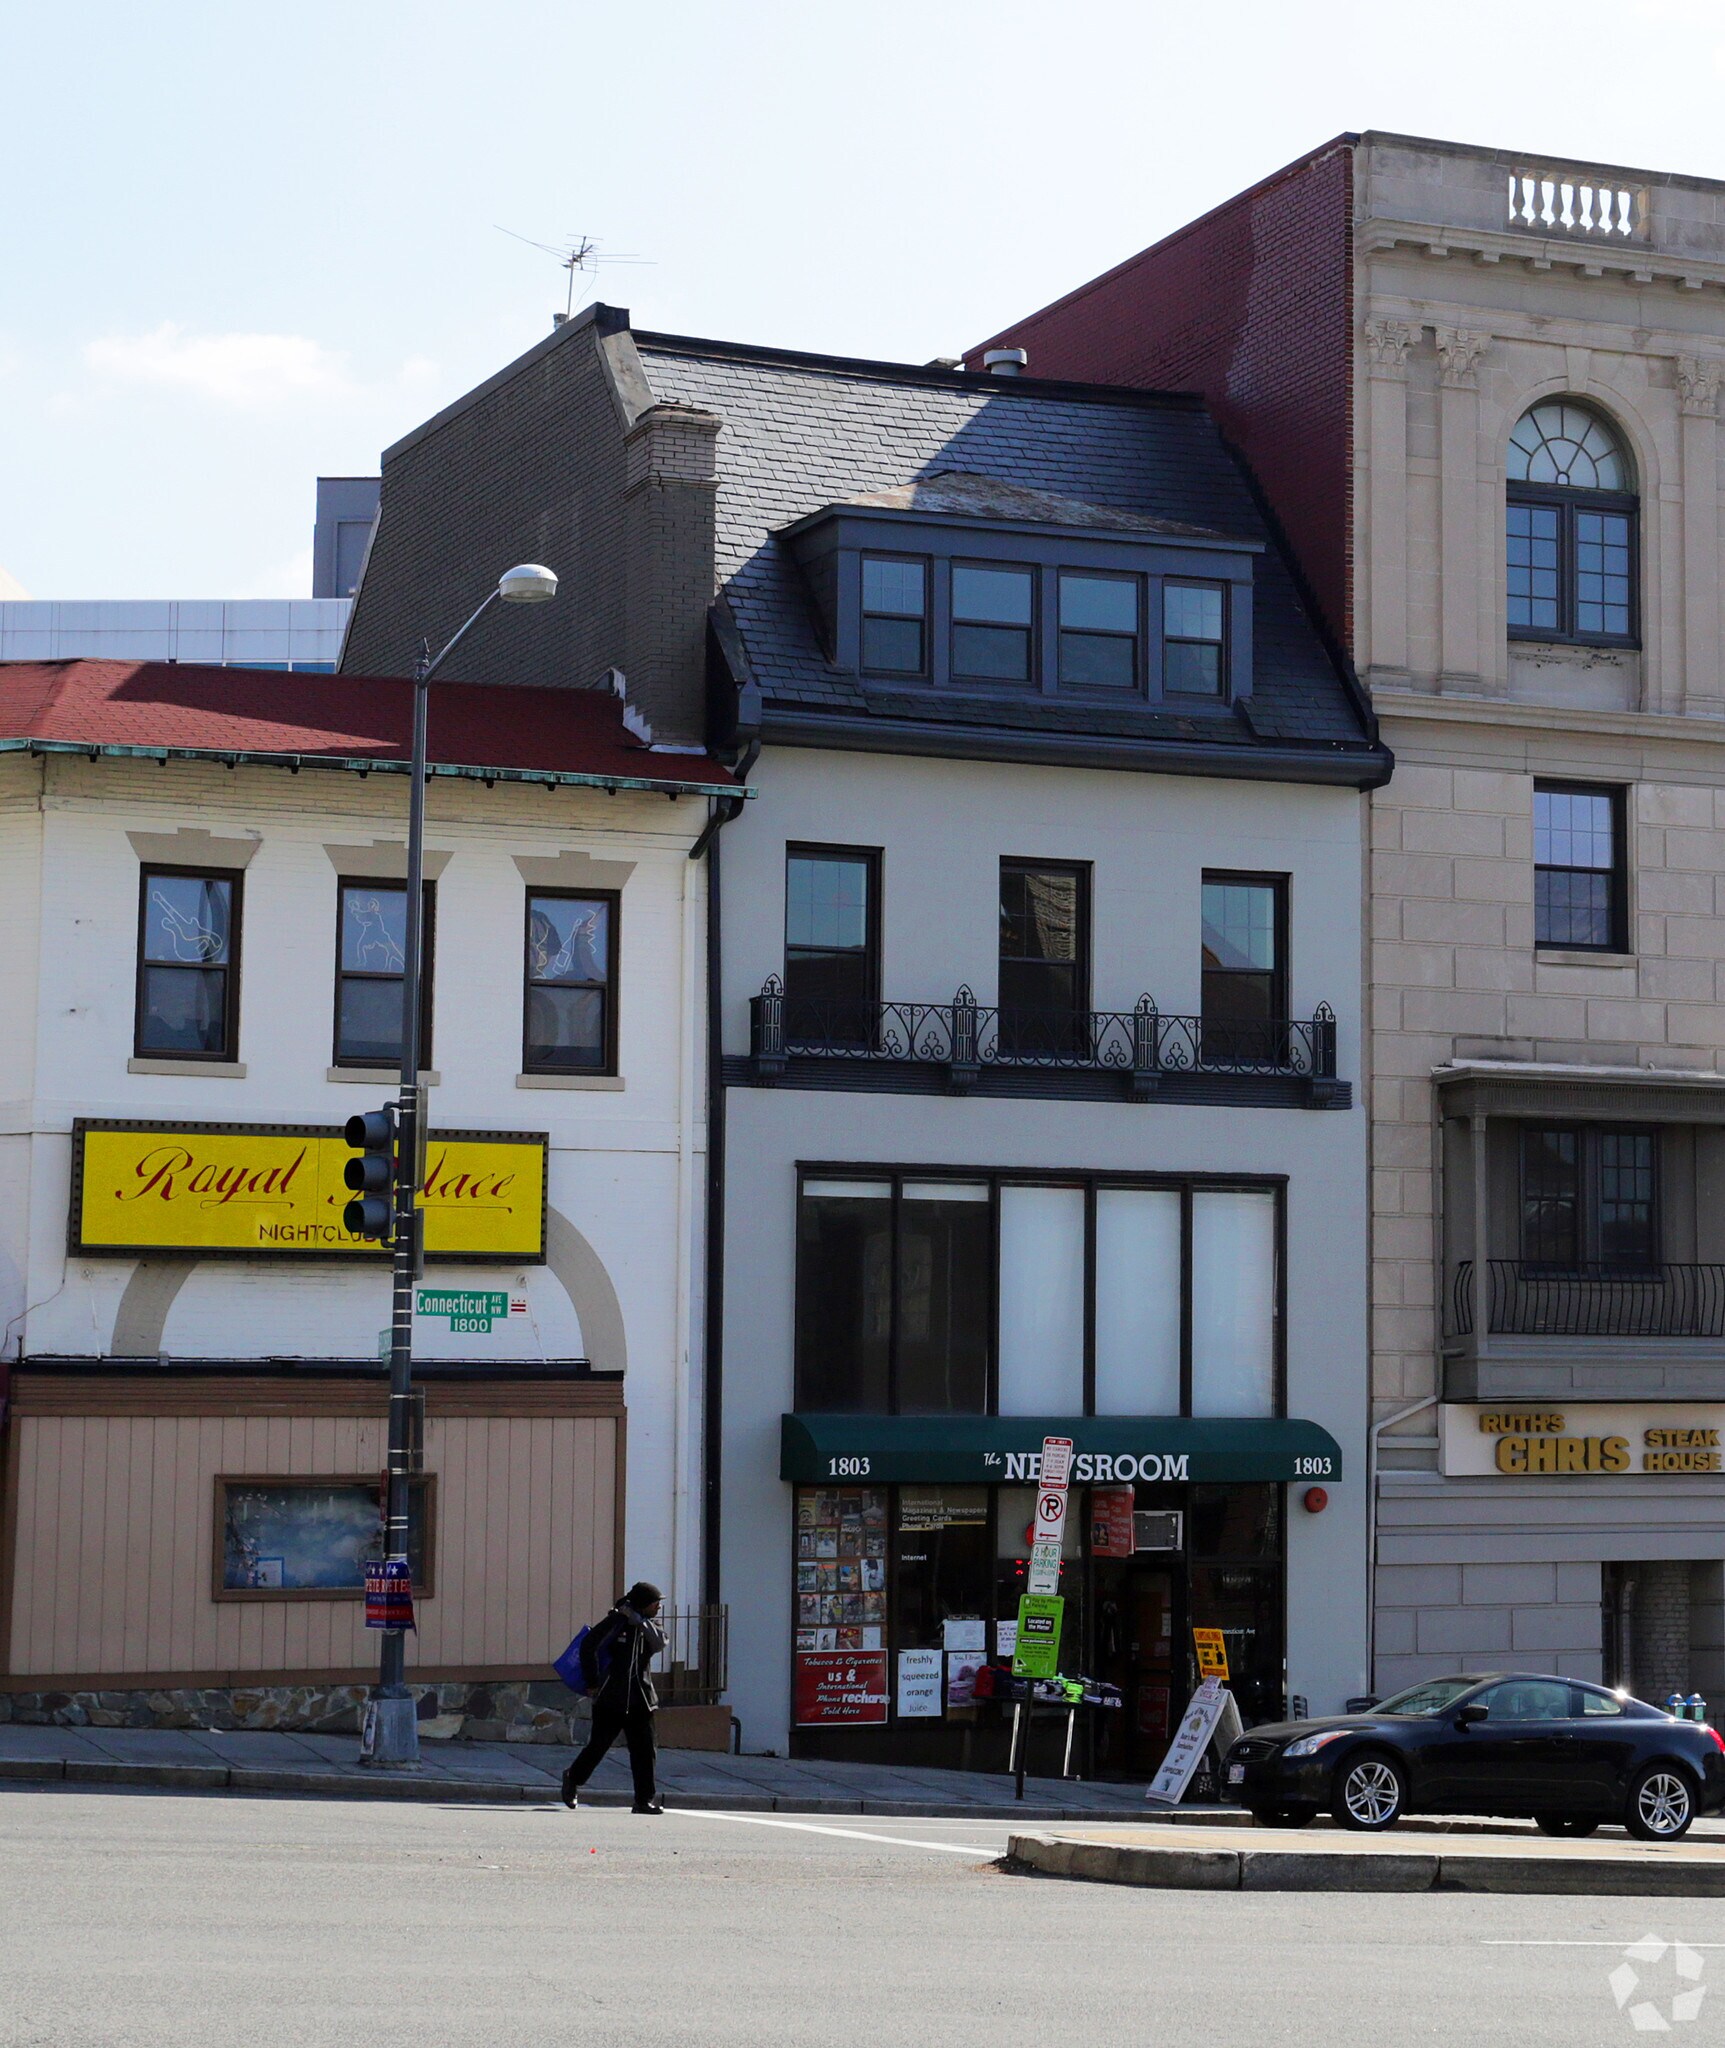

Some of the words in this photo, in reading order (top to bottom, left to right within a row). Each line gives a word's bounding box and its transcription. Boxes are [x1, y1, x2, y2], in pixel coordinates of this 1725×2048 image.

[115, 1146, 307, 1209] Royal
[327, 1148, 515, 1208] lace
[417, 1293, 487, 1314] Connecticut
[491, 1295, 502, 1304] AVE
[491, 1306, 502, 1315] NW
[454, 1318, 488, 1332] 1800
[1643, 1428, 1721, 1447] STEAK
[1495, 1436, 1631, 1473] CHRIS
[828, 1457, 870, 1475] 1803
[984, 1453, 1002, 1466] The
[1004, 1453, 1190, 1481] NESROOM
[1294, 1457, 1332, 1475] 1803
[1643, 1452, 1722, 1471] HOUSE
[902, 1507, 936, 1515] Magazines
[947, 1507, 987, 1515] Newspapers
[1034, 1547, 1039, 1557] 2
[1040, 1548, 1057, 1557] HOUR
[1033, 1558, 1057, 1569] PARKING
[804, 1657, 833, 1666] Tobacco
[845, 1656, 882, 1667] Cigarettes
[906, 1655, 933, 1664] freshly
[846, 1668, 856, 1681] &
[902, 1671, 939, 1681] squeezed
[816, 1681, 868, 1690] International
[816, 1694, 840, 1702] Phone
[906, 1689, 933, 1697] orange
[821, 1707, 840, 1715] Sold
[842, 1706, 860, 1714] Here
